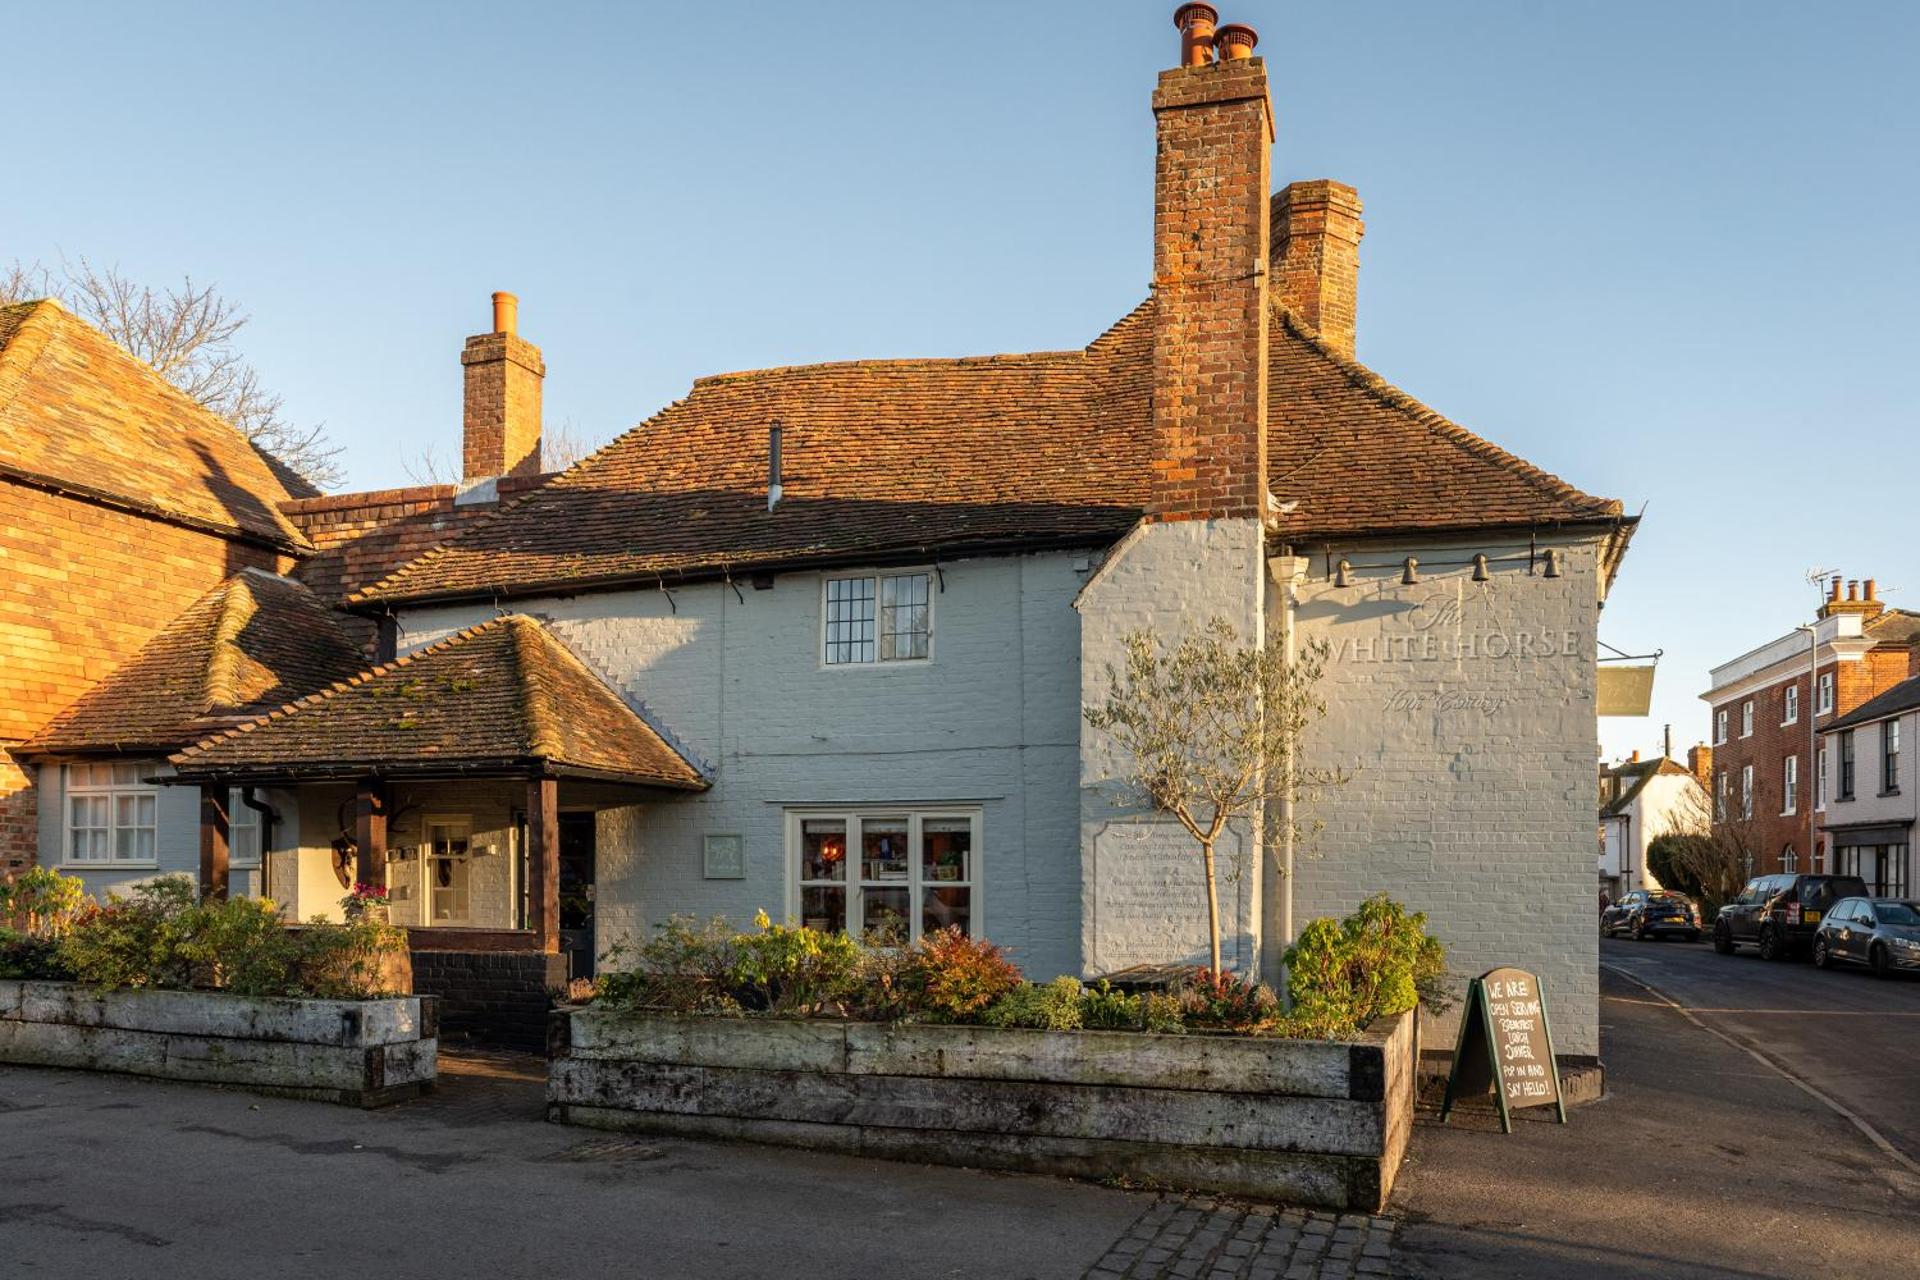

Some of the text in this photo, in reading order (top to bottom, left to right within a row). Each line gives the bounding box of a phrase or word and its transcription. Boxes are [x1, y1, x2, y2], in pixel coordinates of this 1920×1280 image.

[1407, 593, 1477, 631] The
[1451, 629, 1579, 660] HORSE
[1488, 981, 1528, 999] WE ARE
[1490, 1000, 1541, 1016] OPEN SERVING
[1504, 1044, 1535, 1060] DINNER
[1503, 1064, 1544, 1077] POP IN AND
[1507, 1080, 1551, 1098] SAY HELLO!
